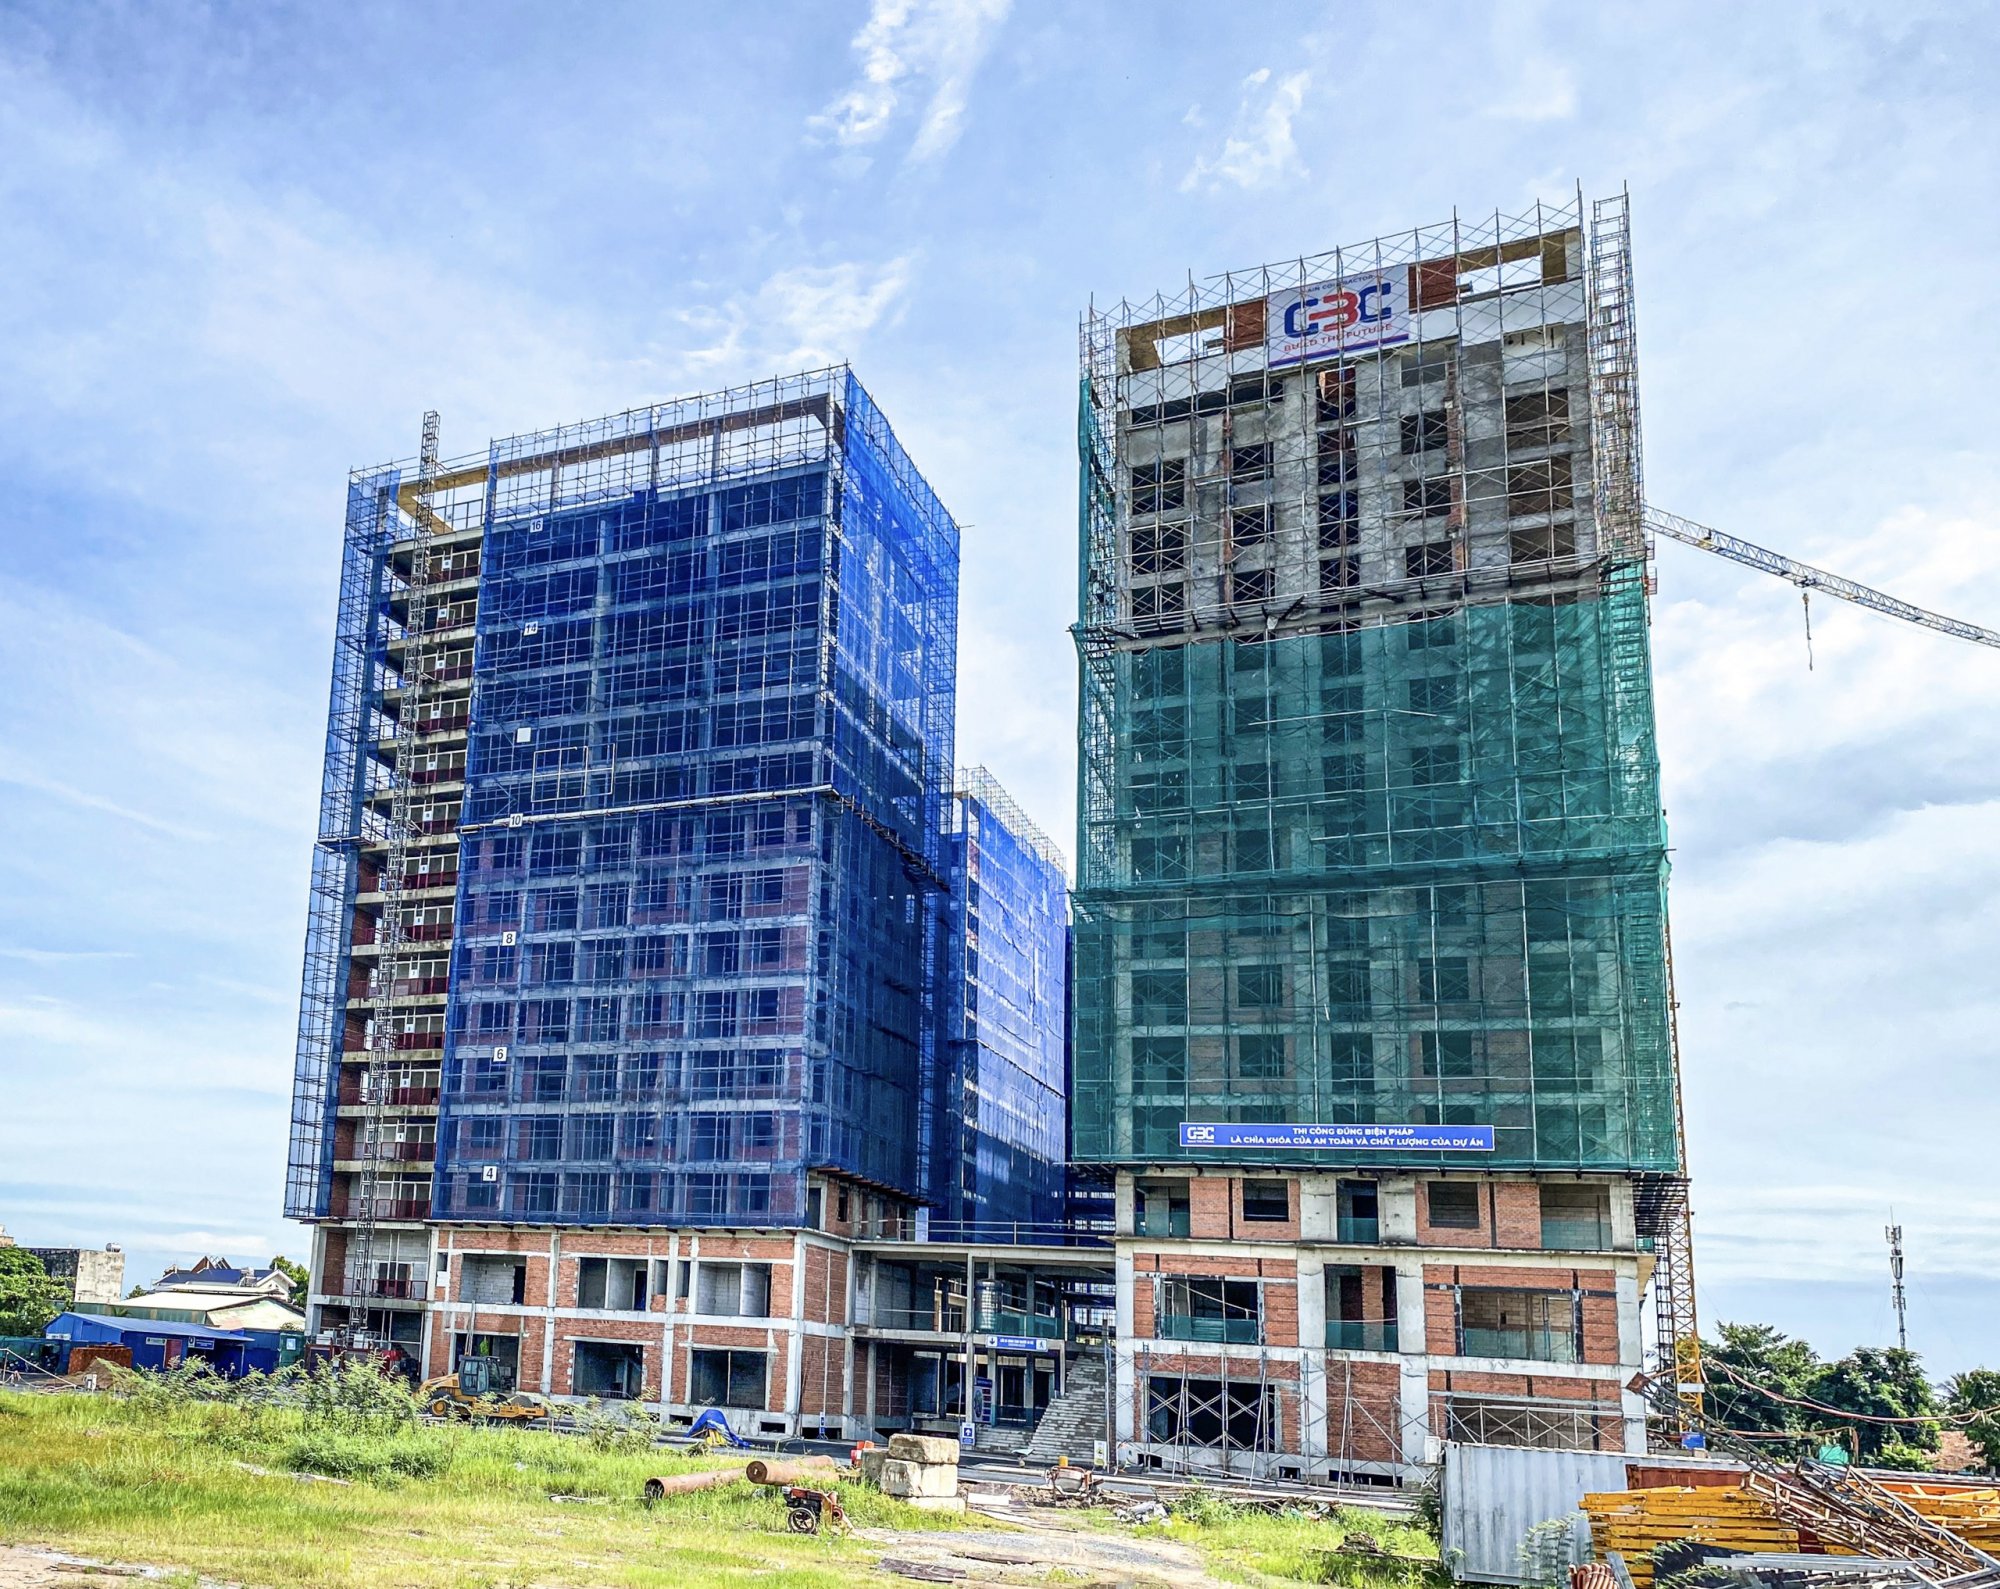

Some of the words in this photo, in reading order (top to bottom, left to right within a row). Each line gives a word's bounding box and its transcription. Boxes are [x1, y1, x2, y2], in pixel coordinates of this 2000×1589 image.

[532, 520, 541, 531] 16
[526, 623, 537, 634] 14
[511, 815, 521, 826] 10
[506, 933, 513, 944] 8
[497, 1048, 504, 1060] 6
[1292, 1127, 1308, 1135] THI
[1309, 1126, 1335, 1136] CÔNG
[1388, 1127, 1415, 1136] PHÁP
[1230, 1135, 1242, 1144] LÀ
[1243, 1135, 1265, 1144] CHÌA
[1266, 1135, 1292, 1144] KHÓA
[1313, 1137, 1327, 1145] AN
[1328, 1136, 1354, 1145] TOÀN
[1355, 1136, 1369, 1145] VÀ
[1396, 1137, 1429, 1147] LƯỢNG
[1430, 1136, 1451, 1146] CỦA
[1452, 1138, 1468, 1147] DỰ
[1469, 1137, 1484, 1147] ÁN
[486, 1167, 494, 1179] 4
